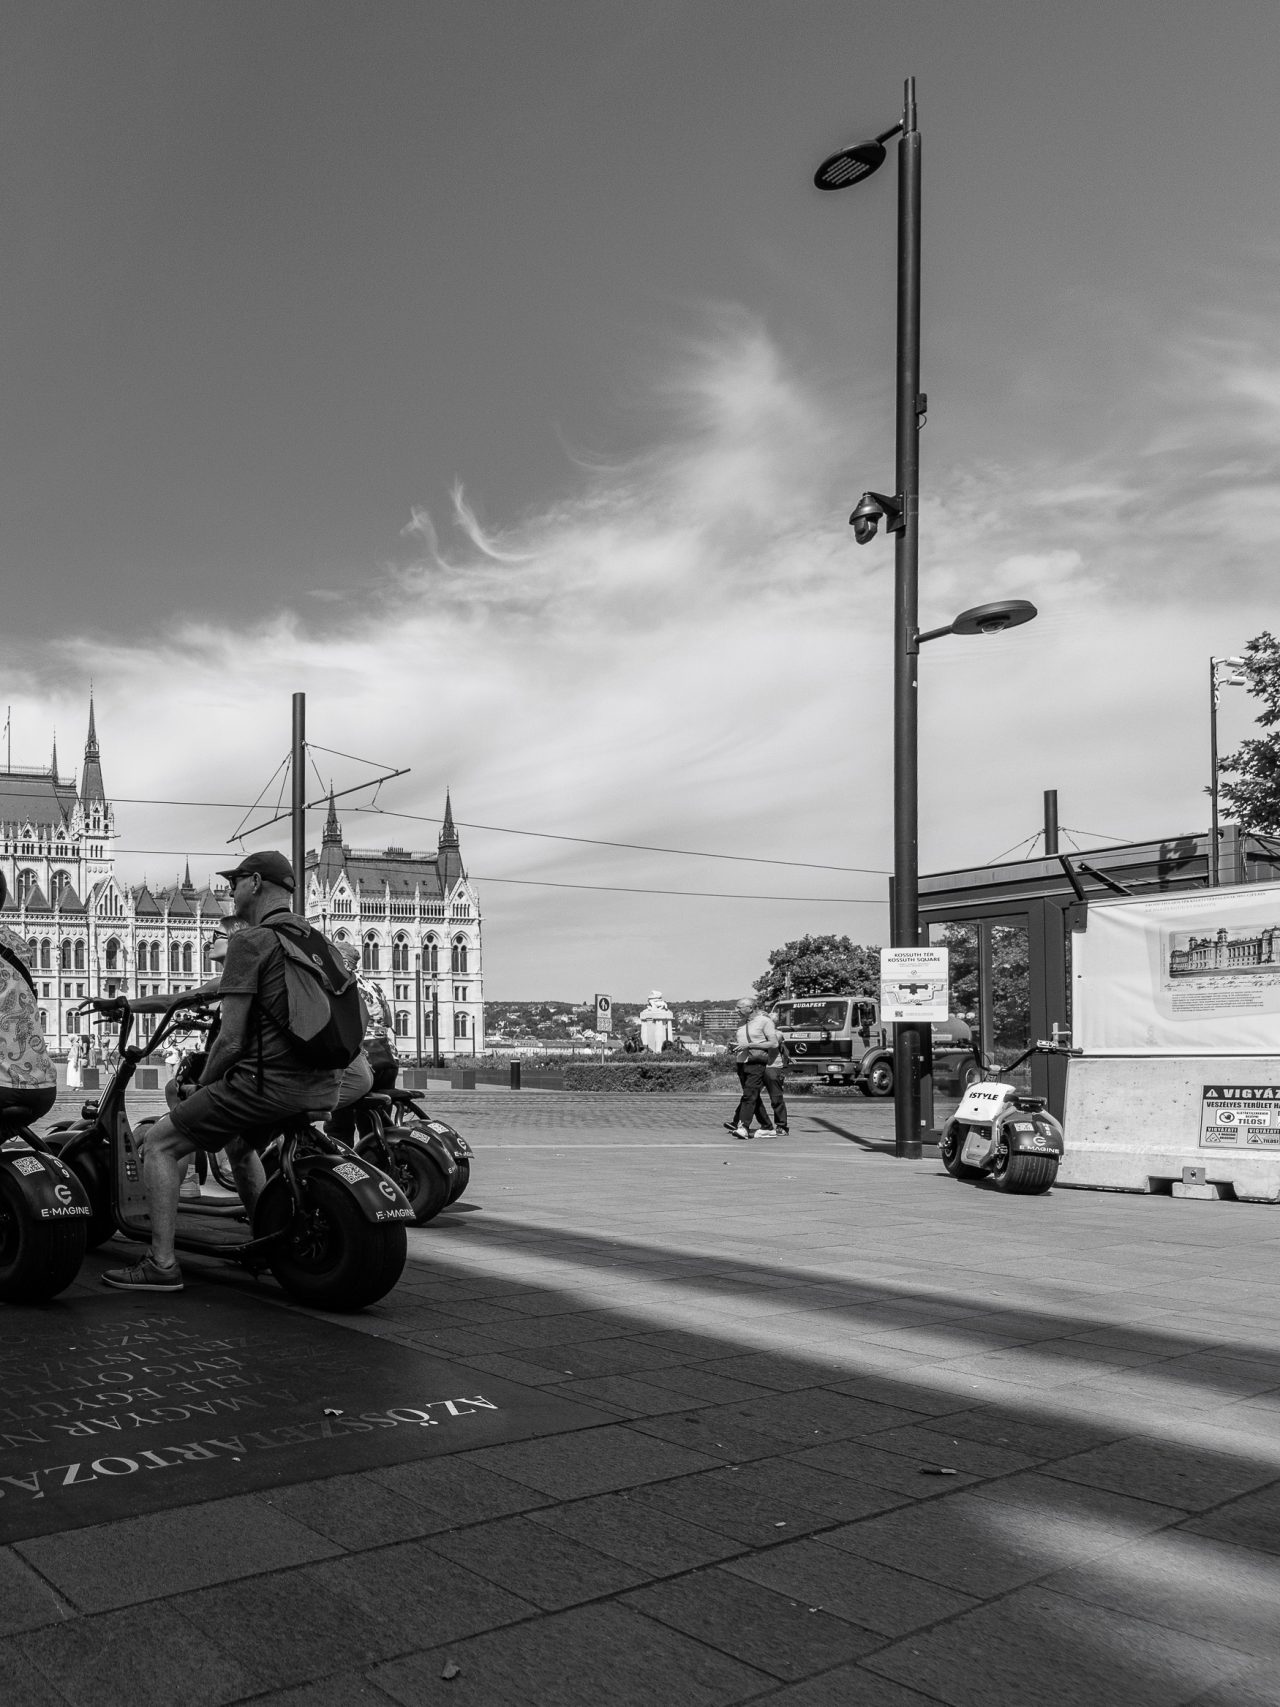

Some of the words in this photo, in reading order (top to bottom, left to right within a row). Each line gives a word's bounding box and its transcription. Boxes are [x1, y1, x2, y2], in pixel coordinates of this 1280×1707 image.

[969, 1091, 999, 1101] iSTYLE
[157, 1335, 277, 1357] SZENT
[141, 1355, 246, 1378] ÉVIG
[52, 1396, 265, 1435] MAGYAR
[425, 1395, 497, 1415] AZ
